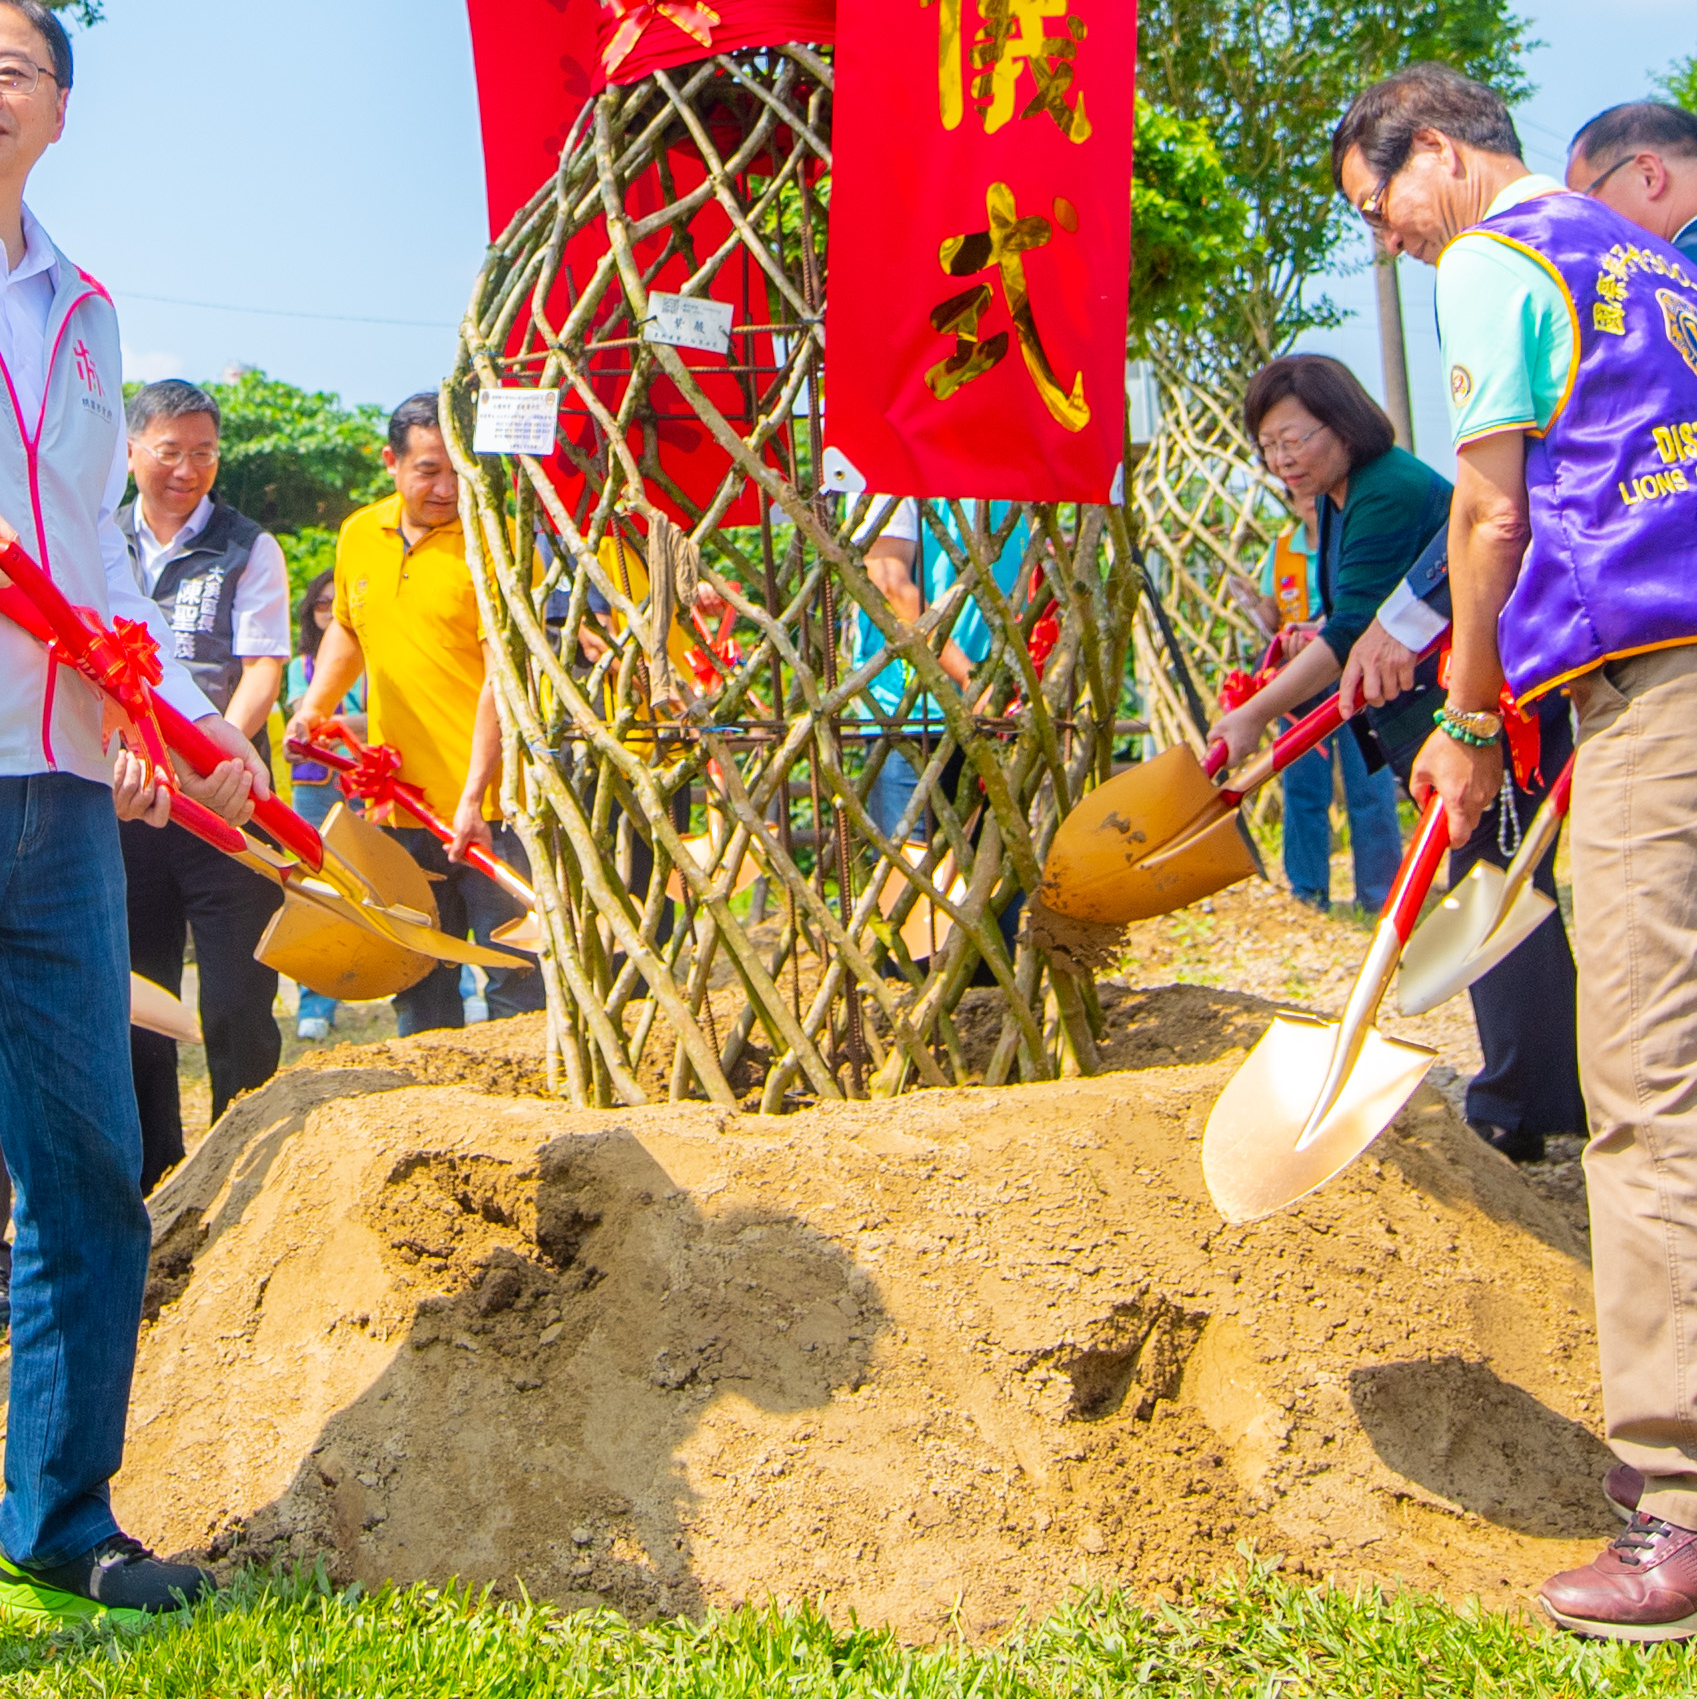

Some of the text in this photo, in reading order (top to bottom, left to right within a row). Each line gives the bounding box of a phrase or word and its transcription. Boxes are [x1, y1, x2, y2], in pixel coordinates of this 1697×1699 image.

[1618, 468, 1690, 506] LIONS
[196, 565, 225, 634] 大溪區長
